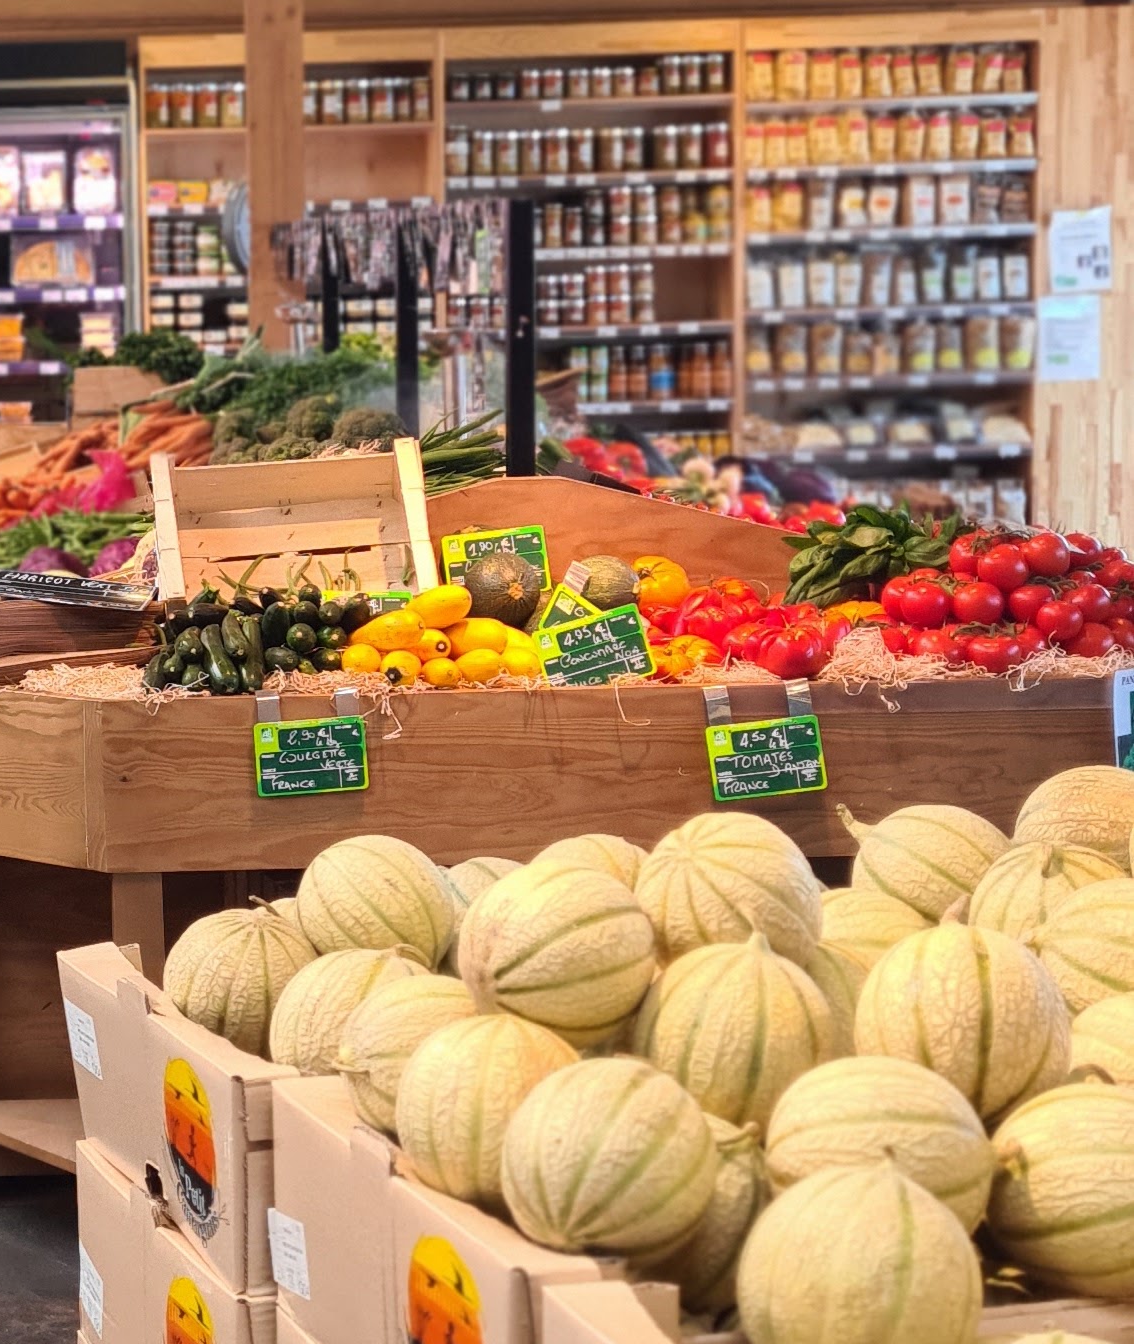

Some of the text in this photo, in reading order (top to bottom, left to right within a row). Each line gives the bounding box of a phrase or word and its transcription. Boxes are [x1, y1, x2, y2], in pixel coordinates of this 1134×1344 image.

[2, 572, 72, 586] HARICOT
[731, 751, 794, 768] TOMATES
[271, 775, 317, 790] FRANCE
[723, 779, 769, 794] FRANCE
